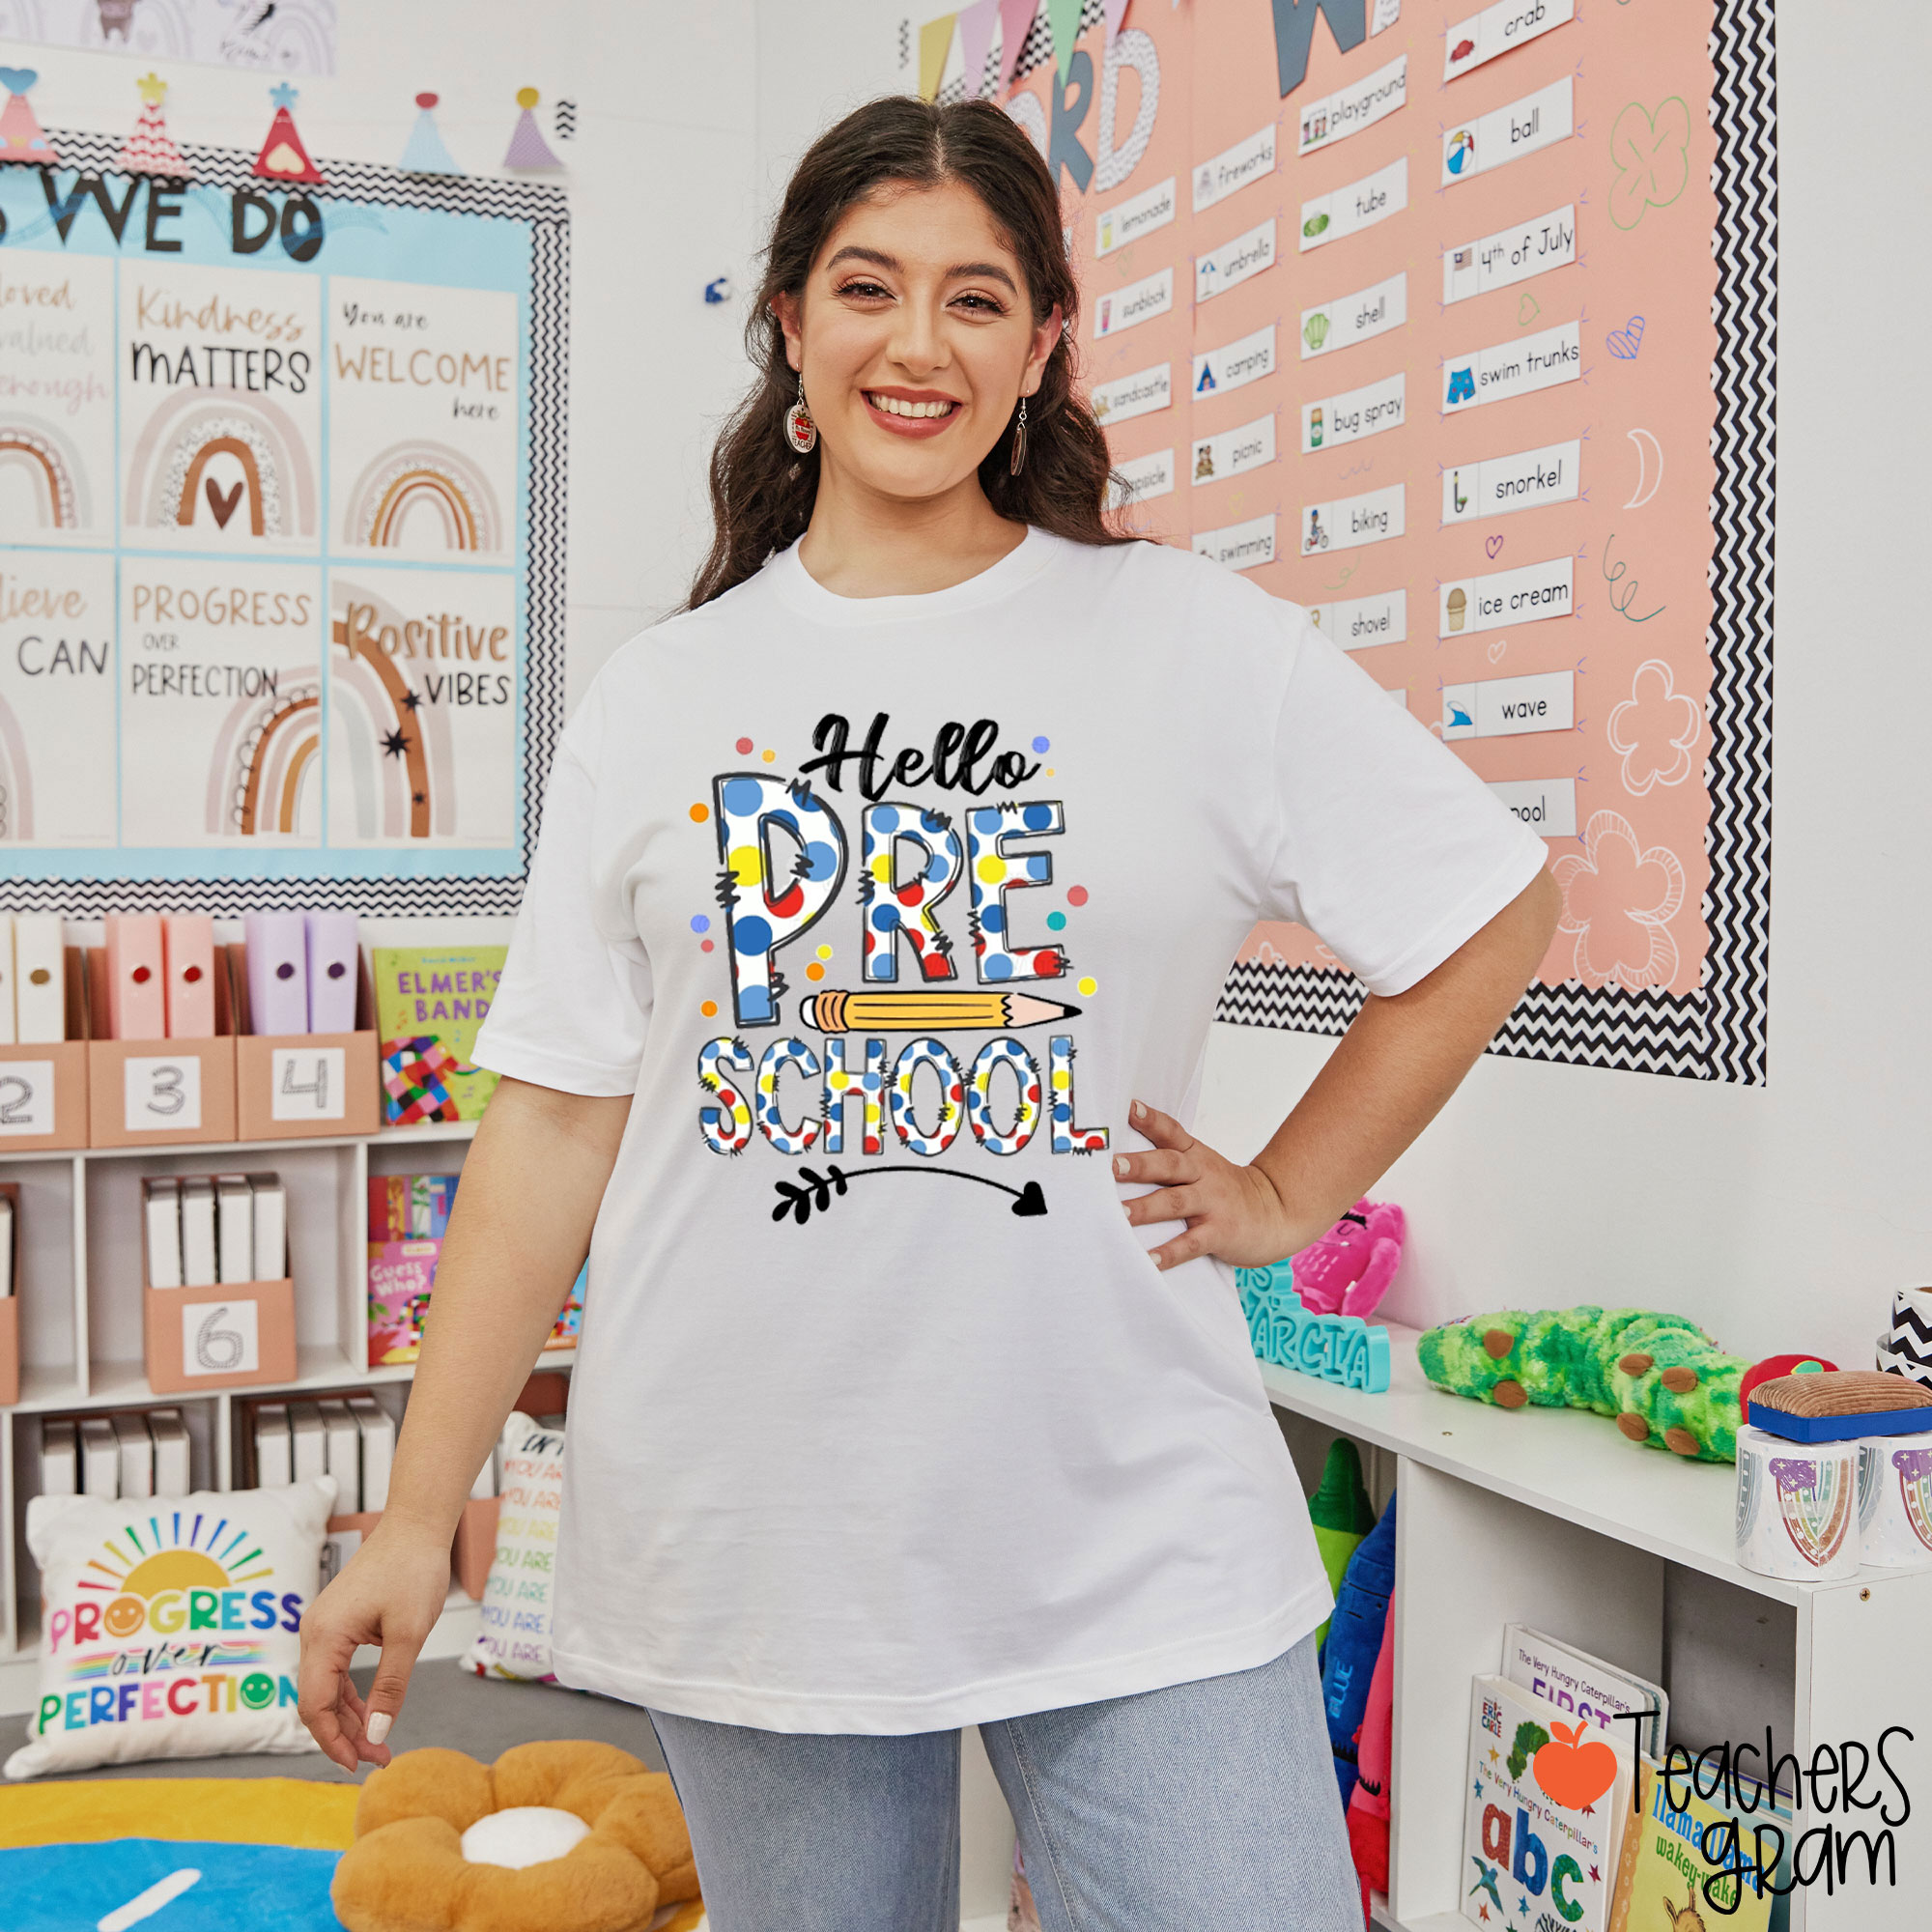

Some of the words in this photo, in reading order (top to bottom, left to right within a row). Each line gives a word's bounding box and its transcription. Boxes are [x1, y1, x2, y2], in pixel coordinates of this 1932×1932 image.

[1504, 0, 1546, 37] crab
[1331, 64, 1406, 130] playground
[1511, 106, 1539, 144] ball
[1218, 145, 1273, 187] fireworks
[37, 166, 187, 253] WE
[232, 188, 324, 262] DO
[1121, 194, 1172, 233] lemonade
[1356, 189, 1387, 218] tube
[1224, 239, 1270, 277] umbrella
[1511, 235, 1532, 266] of
[1538, 223, 1573, 256] July
[135, 286, 306, 342] Kindness
[344, 301, 386, 327] You
[394, 313, 429, 330] are
[1122, 289, 1166, 319] sunblock
[1355, 295, 1386, 329] shell
[336, 344, 512, 392] WELCOME
[1226, 348, 1270, 379] camping
[1480, 362, 1521, 386] swim
[1527, 339, 1580, 374] trunks
[453, 396, 499, 420] here
[1113, 377, 1171, 408] sandcastle
[1334, 409, 1360, 433] bug
[1364, 396, 1404, 423] spray
[1234, 438, 1263, 469] picnic
[1495, 459, 1562, 498] snorkel
[1352, 511, 1389, 535] biking
[1220, 533, 1272, 562] swimming
[133, 584, 313, 626] PROGRESS
[1479, 596, 1503, 616] ice
[1510, 582, 1569, 610] cream
[346, 601, 508, 662] Positive
[1351, 607, 1391, 638] shovel
[18, 635, 108, 675] CAN
[144, 633, 180, 651] OVER
[133, 663, 278, 698] PERFECTION
[424, 671, 512, 705] VIBES
[1501, 697, 1548, 720] wave
[799, 712, 1041, 802] Hello
[711, 771, 1074, 1029] PRE
[415, 998, 491, 1023] BAND
[0, 1076, 34, 1123] 2
[147, 1065, 186, 1115] 3
[281, 1059, 328, 1109] 4
[697, 1035, 1110, 1157] SCHOOL
[370, 1262, 422, 1283] Guess
[374, 1274, 427, 1297] Who?
[196, 1306, 244, 1370] 6
[1242, 1299, 1371, 1387] ARCIA
[522, 1549, 554, 1574] ARE
[517, 1580, 548, 1604] ARE
[50, 1590, 303, 1654] PROGRESS
[513, 1610, 546, 1635] ARE
[112, 1641, 224, 1676] over
[1327, 1660, 1353, 1719] BLUE
[1519, 1648, 1532, 1665] The
[1533, 1655, 1549, 1677] Very
[1551, 1665, 1579, 1691] Hungry
[1580, 1680, 1632, 1714] Caterpillar's
[38, 1672, 299, 1735] PERFECTION
[1483, 1702, 1503, 1725] ERIC
[1481, 1715, 1502, 1739] CARLE
[1479, 1761, 1492, 1779] The
[1494, 1773, 1512, 1797] Very
[1513, 1786, 1543, 1819] Hungry
[1544, 1808, 1598, 1855] Caterpillar's
[1652, 1783, 1703, 1851] llama
[1482, 1803, 1584, 1922] abc
